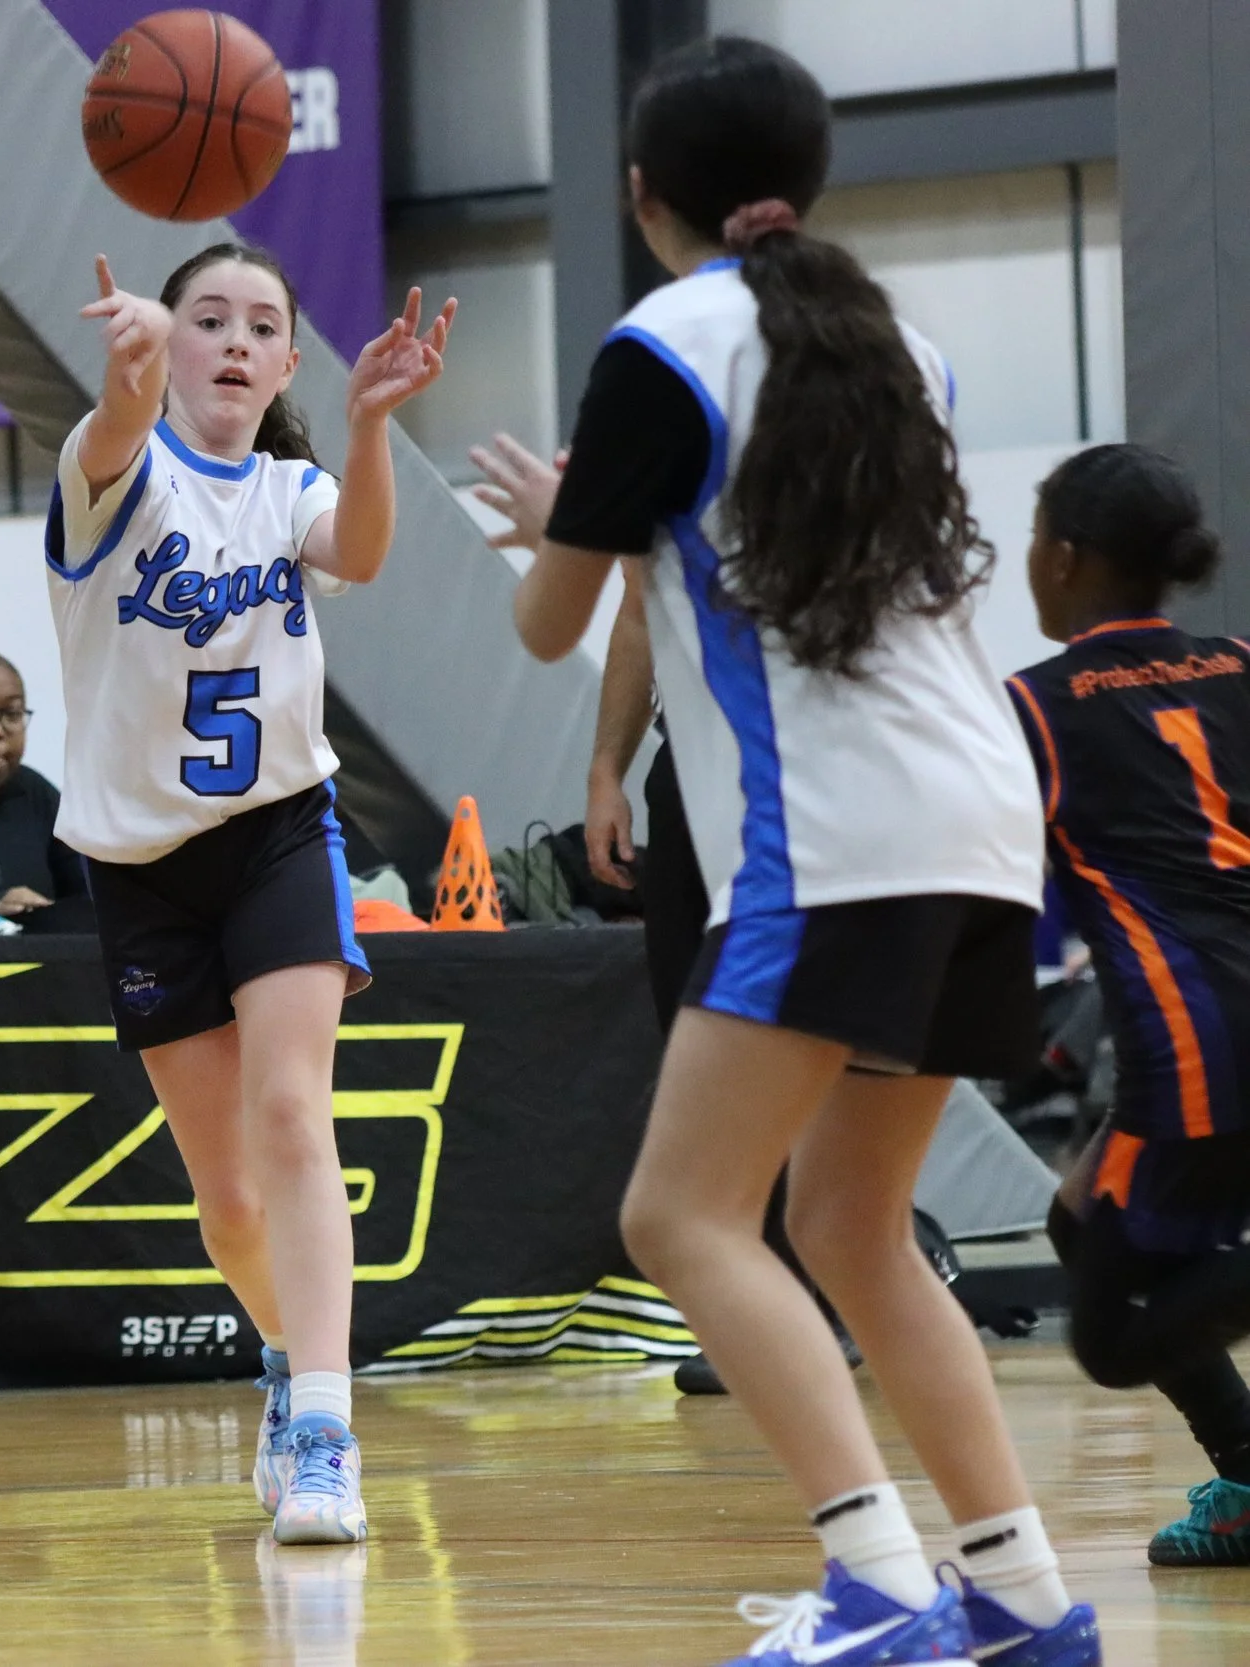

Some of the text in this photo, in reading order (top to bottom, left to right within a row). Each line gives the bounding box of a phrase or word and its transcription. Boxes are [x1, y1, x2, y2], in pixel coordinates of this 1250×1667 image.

[180, 666, 262, 797] 5
[123, 980, 156, 994] Legacy
[120, 1314, 239, 1345] 3STEP
[121, 1344, 237, 1358] SPORTS
